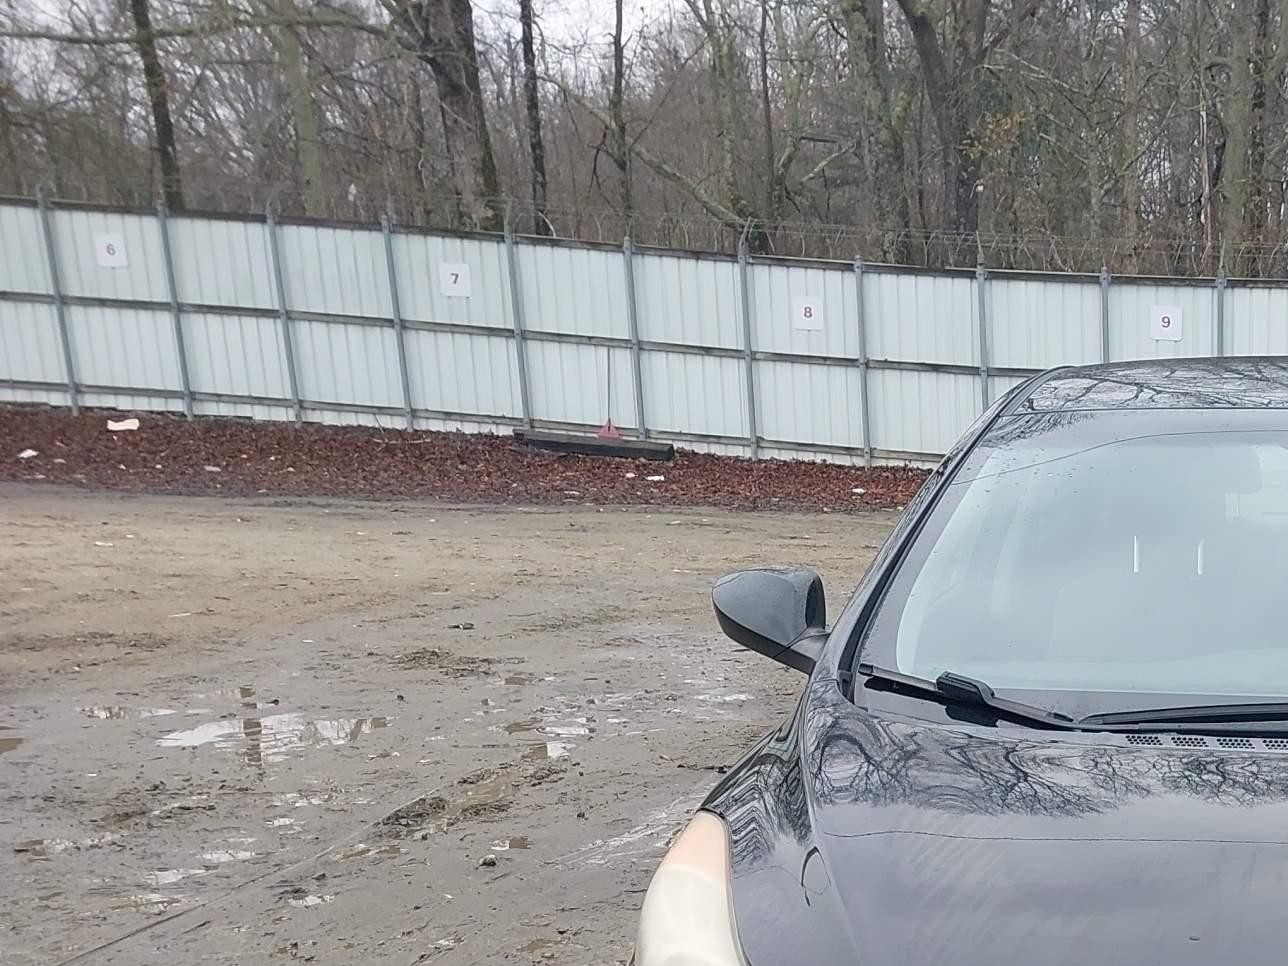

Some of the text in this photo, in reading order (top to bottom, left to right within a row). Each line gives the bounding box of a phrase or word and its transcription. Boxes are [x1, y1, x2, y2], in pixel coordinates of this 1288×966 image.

[105, 243, 116, 256] 6
[450, 272, 460, 285] 7
[803, 306, 813, 318] 8
[1161, 316, 1171, 328] 9
